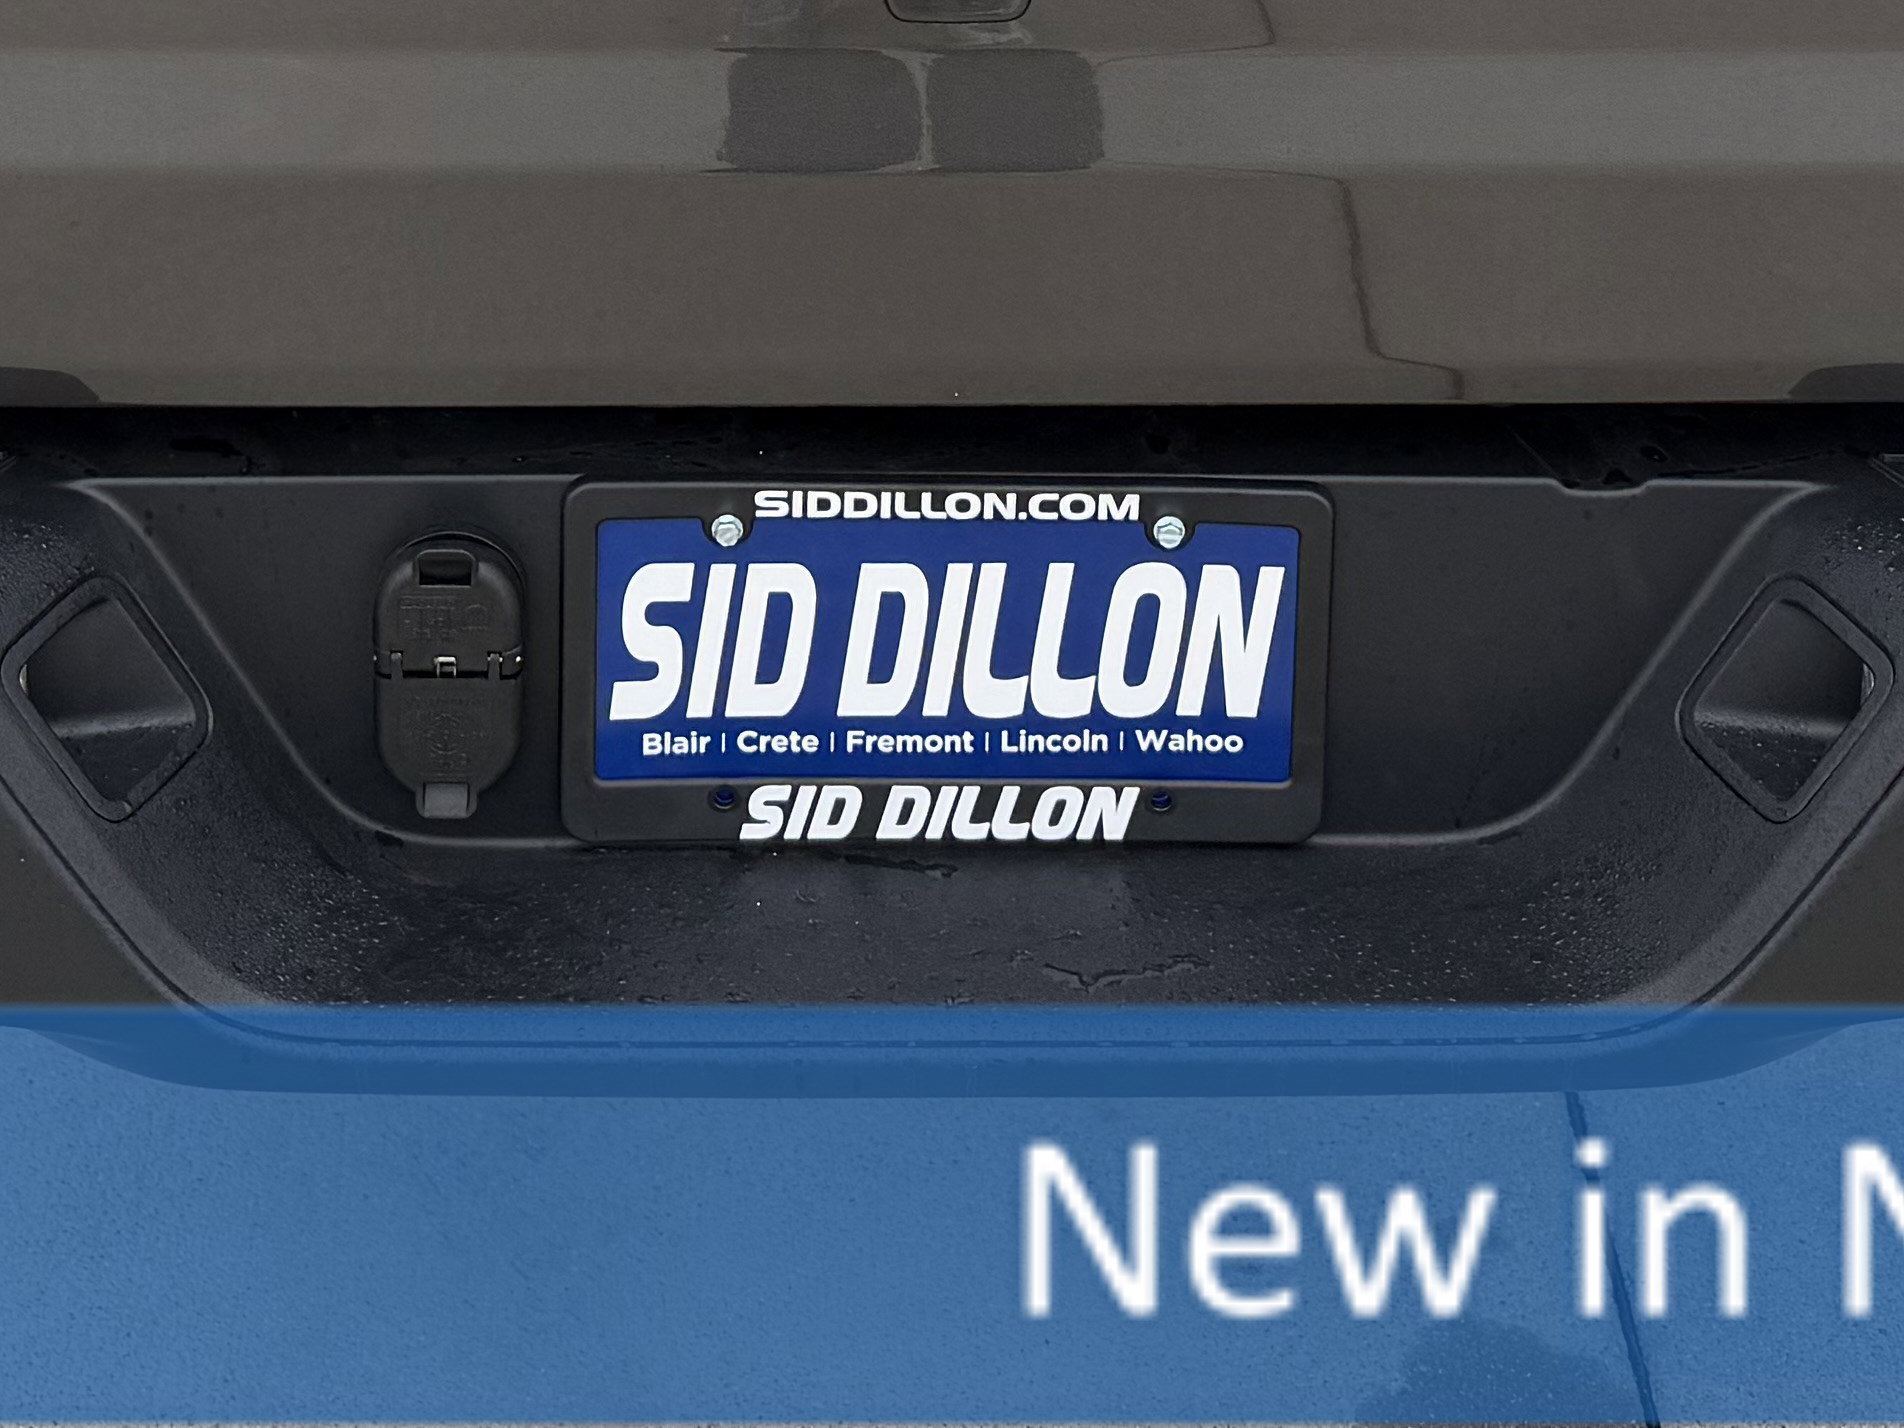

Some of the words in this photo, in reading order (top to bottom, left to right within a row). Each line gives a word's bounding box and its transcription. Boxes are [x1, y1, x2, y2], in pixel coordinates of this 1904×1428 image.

[754, 489, 1141, 521] SIDDILLON.COM
[609, 562, 817, 721] SID
[836, 561, 1286, 720] DILLON
[642, 730, 712, 755] Blair
[736, 730, 820, 754] Crete
[846, 730, 975, 754] Fremont
[1001, 728, 1109, 754] Lincoln
[1134, 728, 1244, 754] Wahoo
[739, 784, 863, 841] SID
[875, 784, 1141, 841] DILLON
